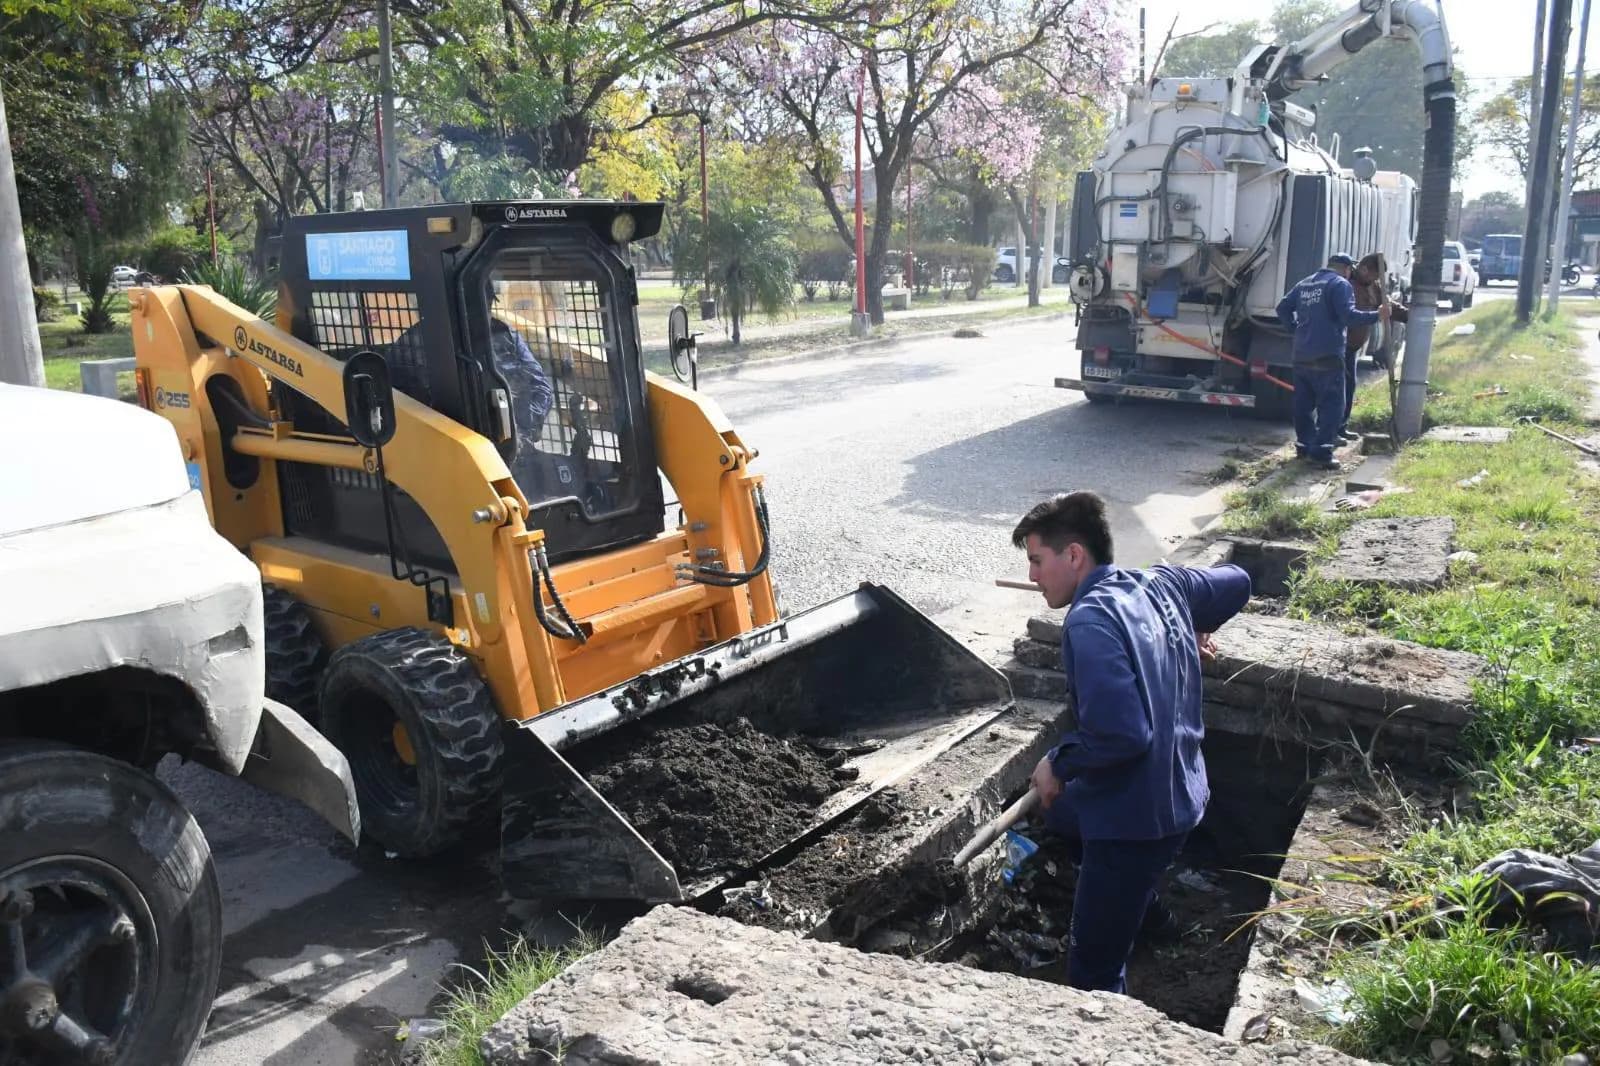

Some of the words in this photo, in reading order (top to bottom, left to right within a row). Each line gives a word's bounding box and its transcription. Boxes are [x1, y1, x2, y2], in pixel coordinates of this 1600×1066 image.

[519, 208, 568, 218] ASTARSA
[338, 236, 395, 256] SANTIAGO
[248, 337, 304, 377] ASTARSA
[165, 391, 190, 408] 255
